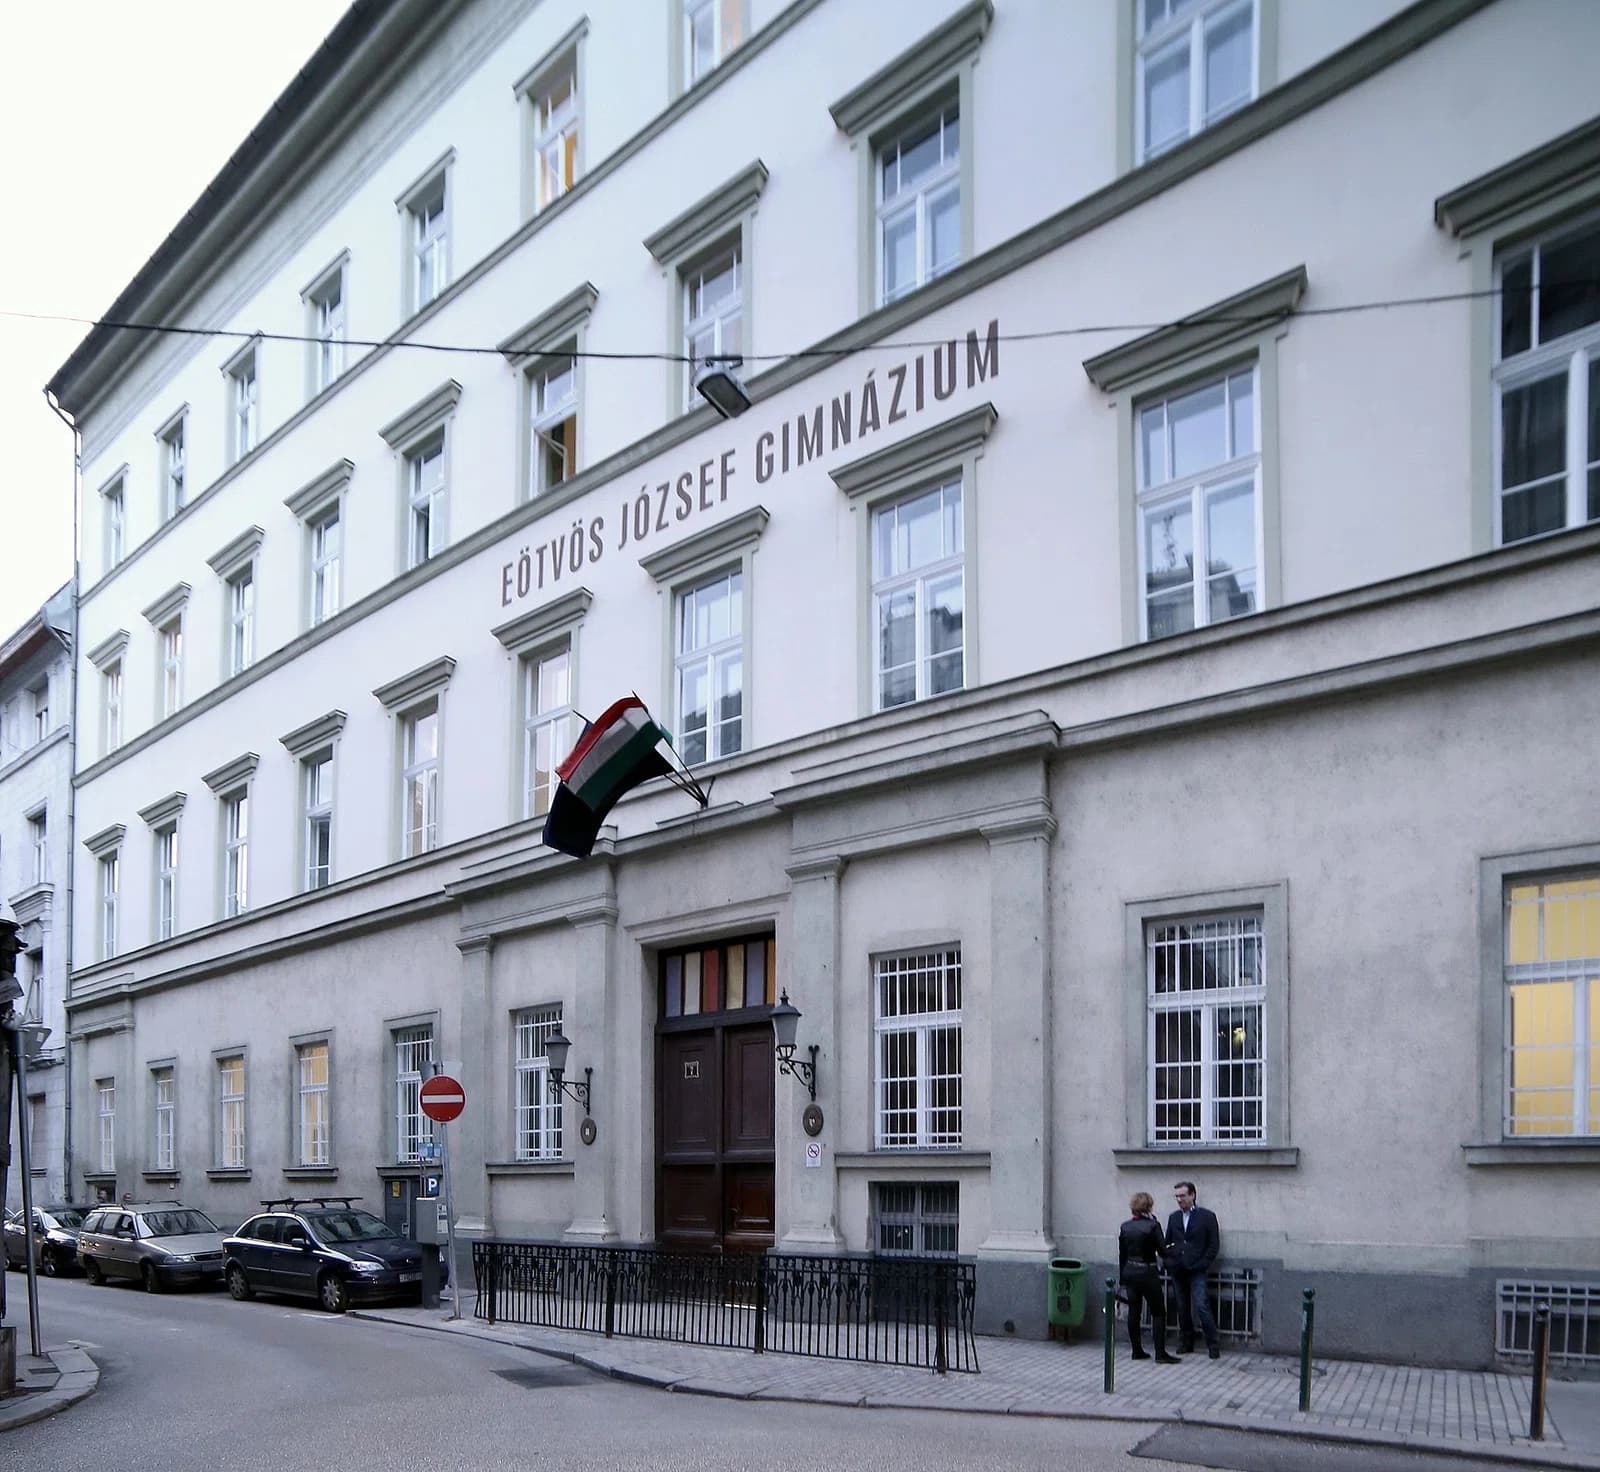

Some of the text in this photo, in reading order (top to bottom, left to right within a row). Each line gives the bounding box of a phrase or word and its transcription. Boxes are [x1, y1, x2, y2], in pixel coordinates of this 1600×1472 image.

[502, 319, 999, 606] EÖTVÖS JÓZSEF GIMNÁZIUM
[428, 1178, 438, 1192] P
